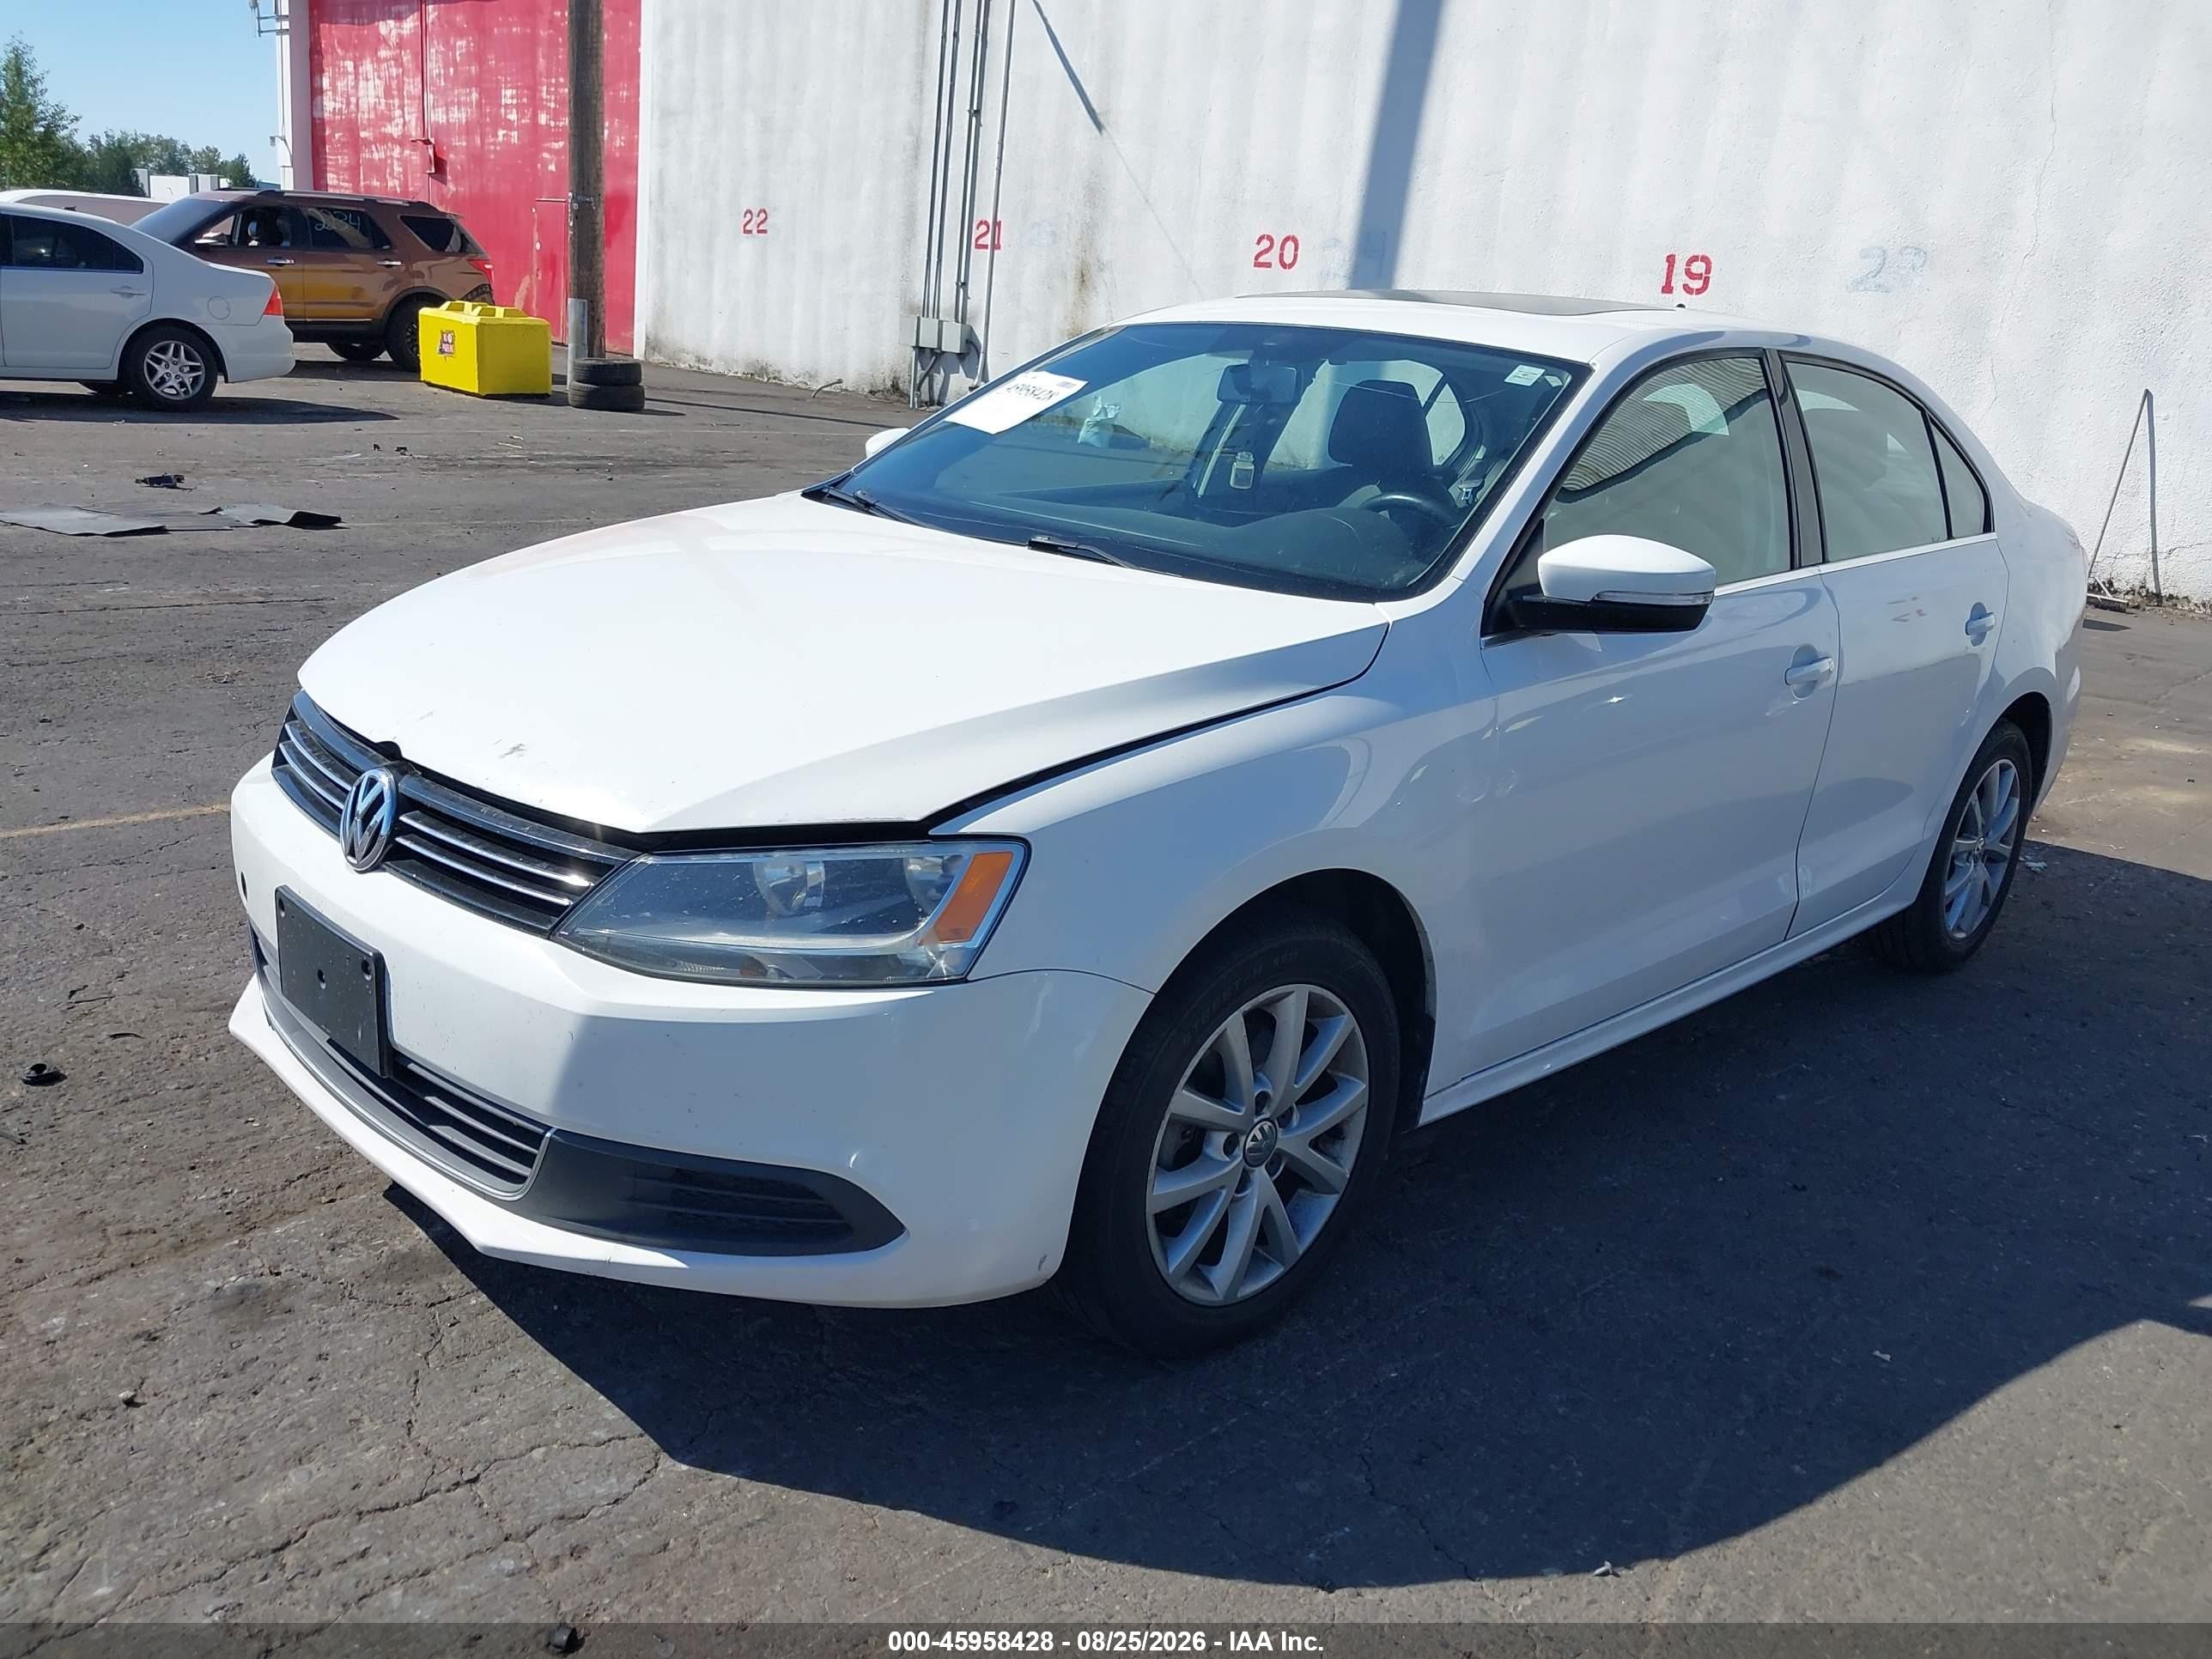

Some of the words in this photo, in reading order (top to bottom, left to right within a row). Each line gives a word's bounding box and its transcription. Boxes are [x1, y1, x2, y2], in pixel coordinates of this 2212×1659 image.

[743, 209, 768, 234] 22
[975, 220, 1001, 250] 21
[1253, 234, 1299, 270] 20
[1661, 253, 1712, 295] 19
